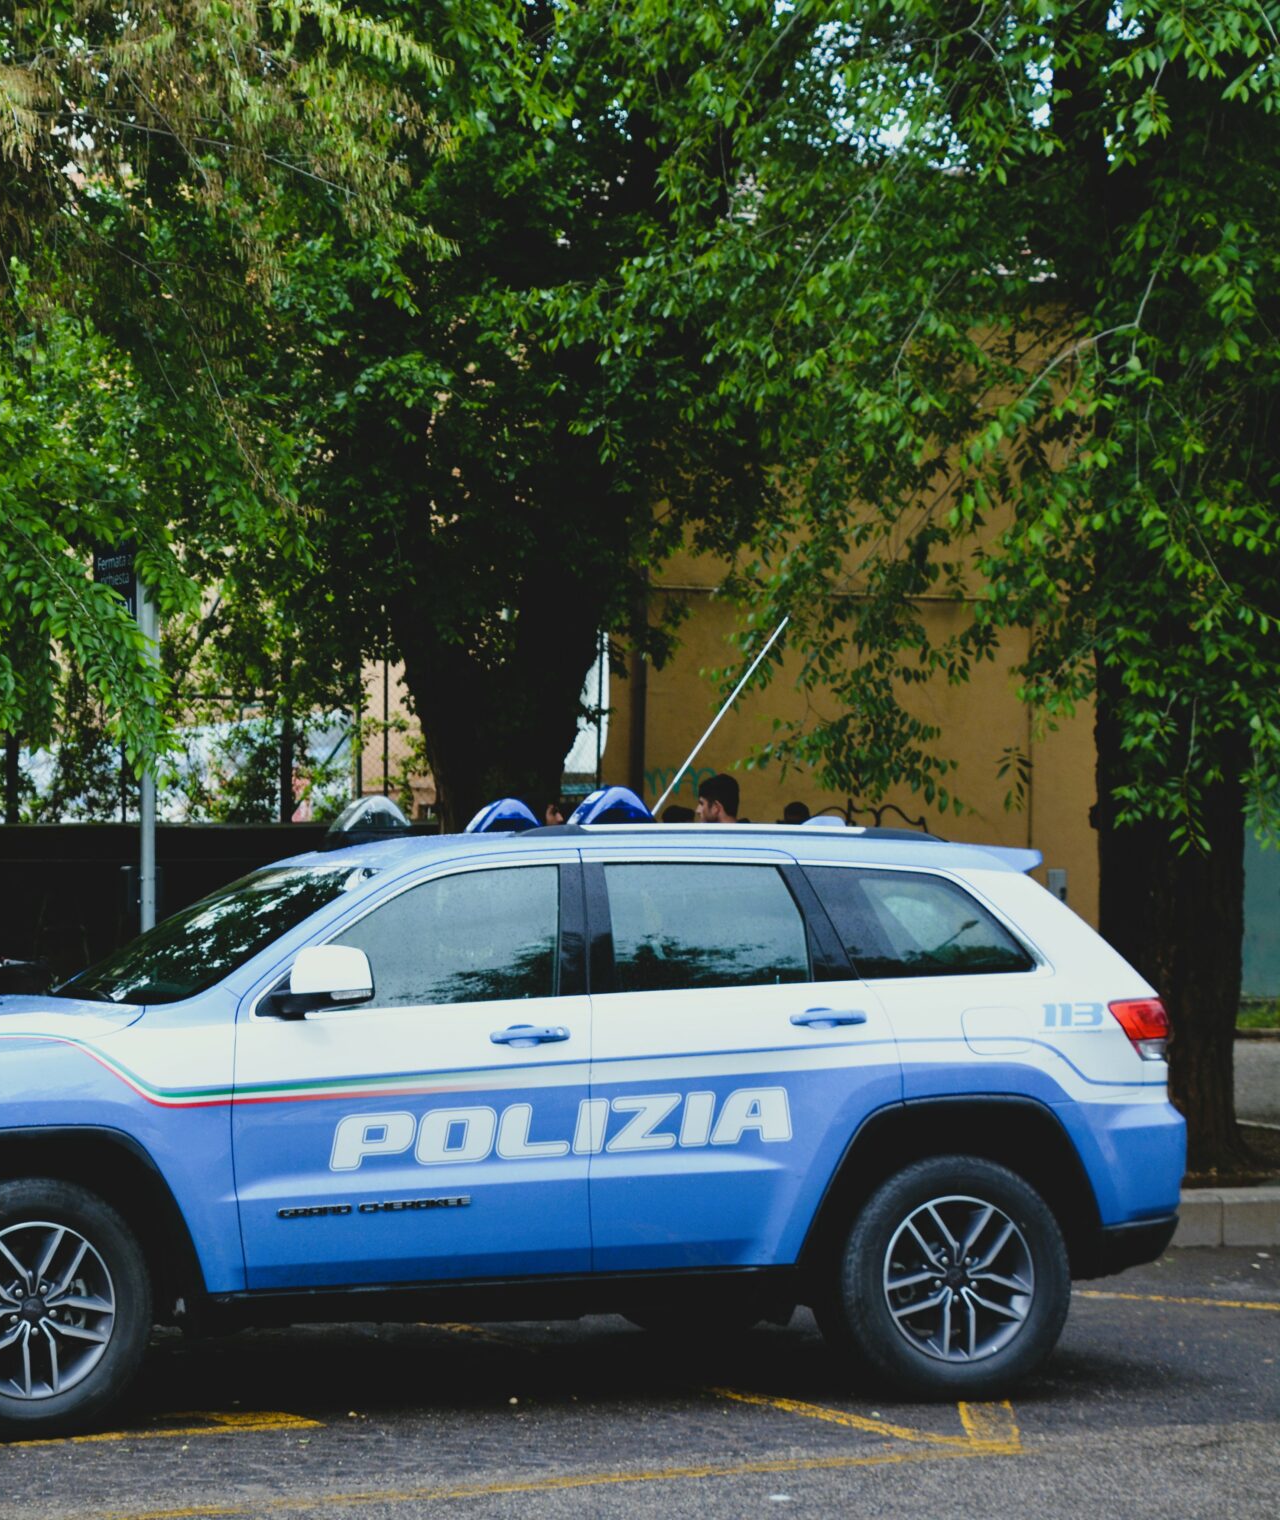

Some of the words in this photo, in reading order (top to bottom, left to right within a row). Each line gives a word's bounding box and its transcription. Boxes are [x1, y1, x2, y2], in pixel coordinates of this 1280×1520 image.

[97, 554, 126, 571] Fermata
[1041, 1002, 1104, 1027] 113
[329, 1086, 793, 1172] POLIZIA
[278, 1203, 352, 1219] GRAND
[358, 1195, 471, 1214] CHEROKEE
